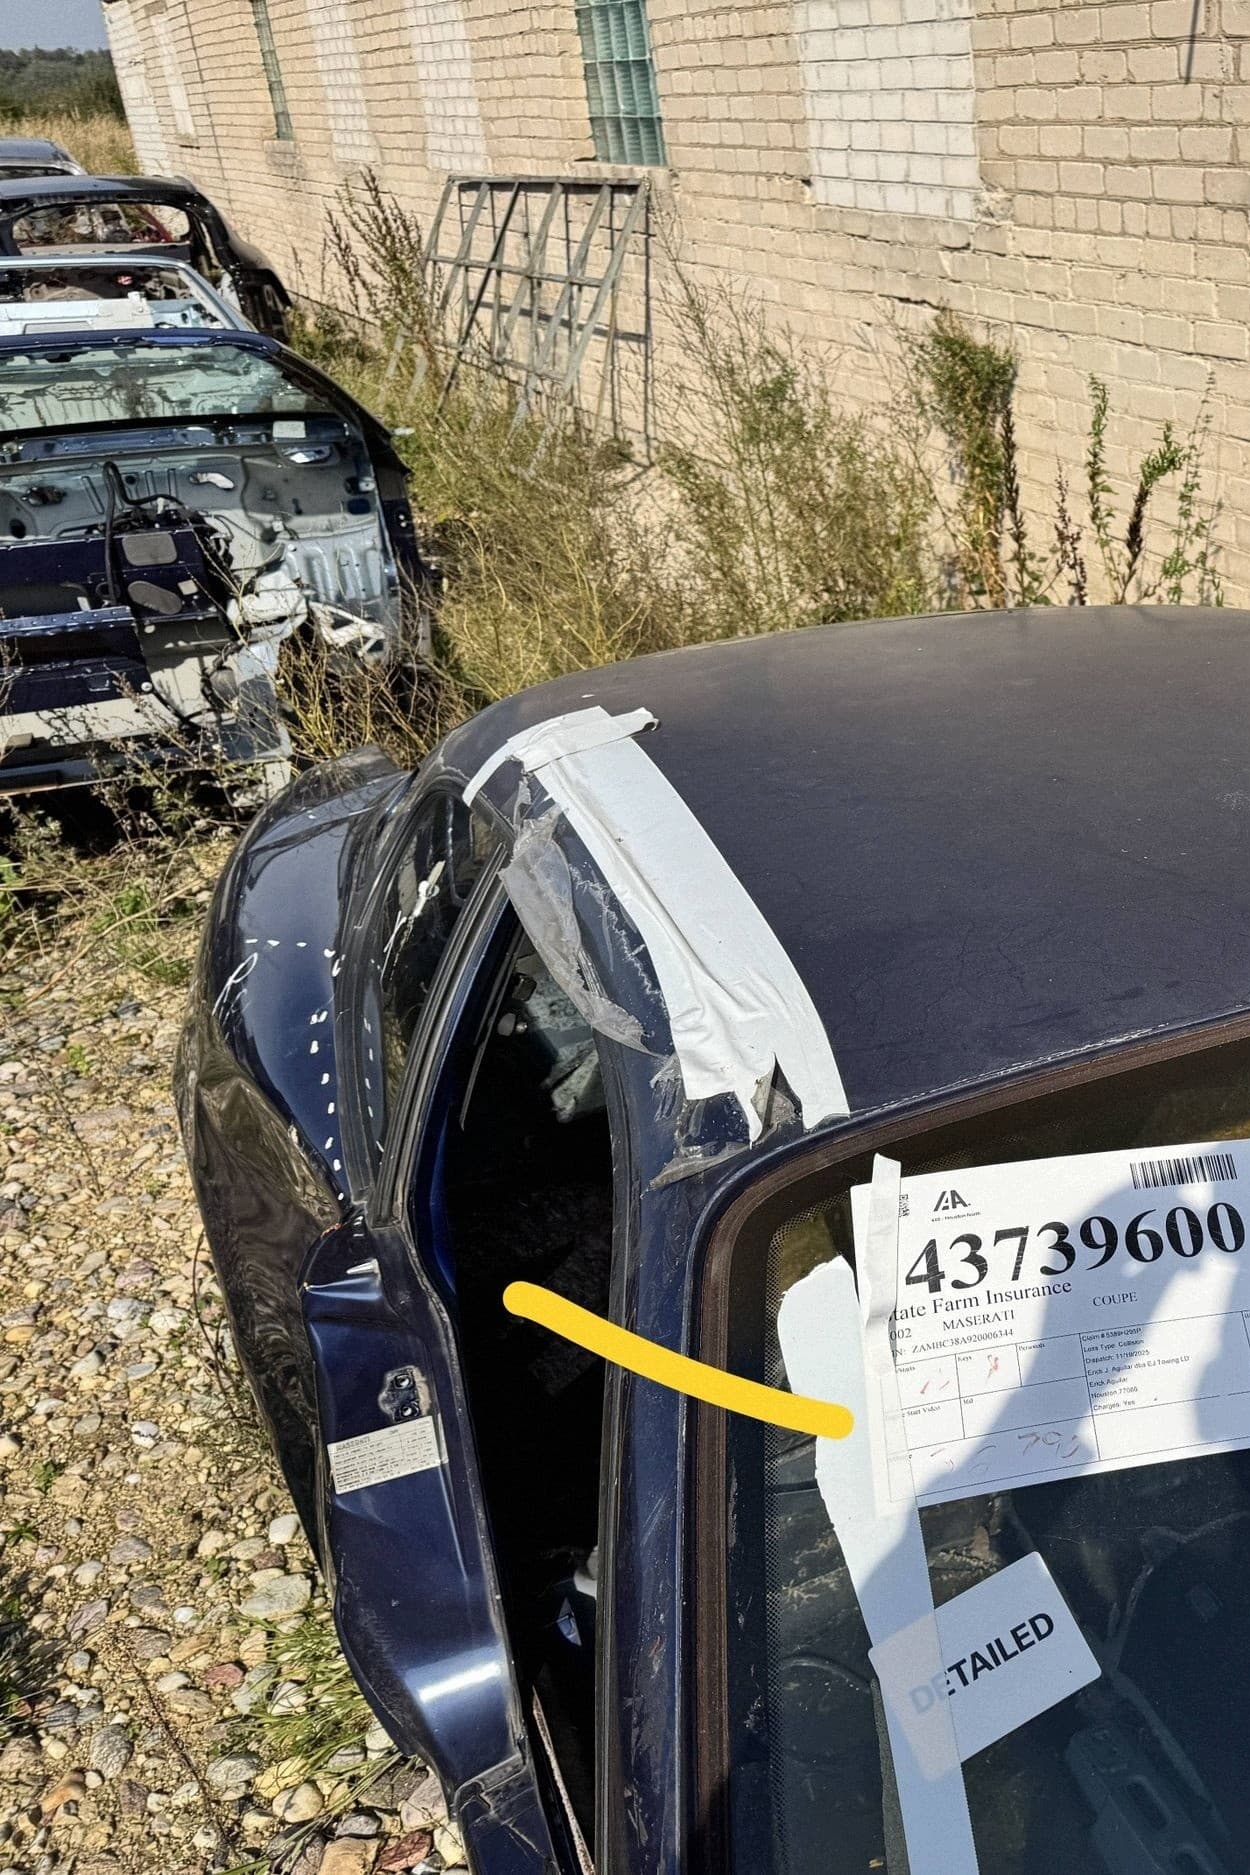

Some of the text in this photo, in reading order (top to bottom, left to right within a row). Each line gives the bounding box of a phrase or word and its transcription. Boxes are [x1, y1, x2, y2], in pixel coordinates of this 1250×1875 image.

[905, 1201, 1246, 1294] 43739600
[889, 1281, 1072, 1322] tate Farm Insurance
[942, 1309, 1015, 1332] MASERATI
[1092, 1291, 1138, 1307] COUPE
[1118, 1338, 1144, 1348] Collision
[1157, 1356, 1180, 1367] Towing
[1091, 1390, 1118, 1400] Houston
[908, 1611, 1055, 1714] DETAILED
